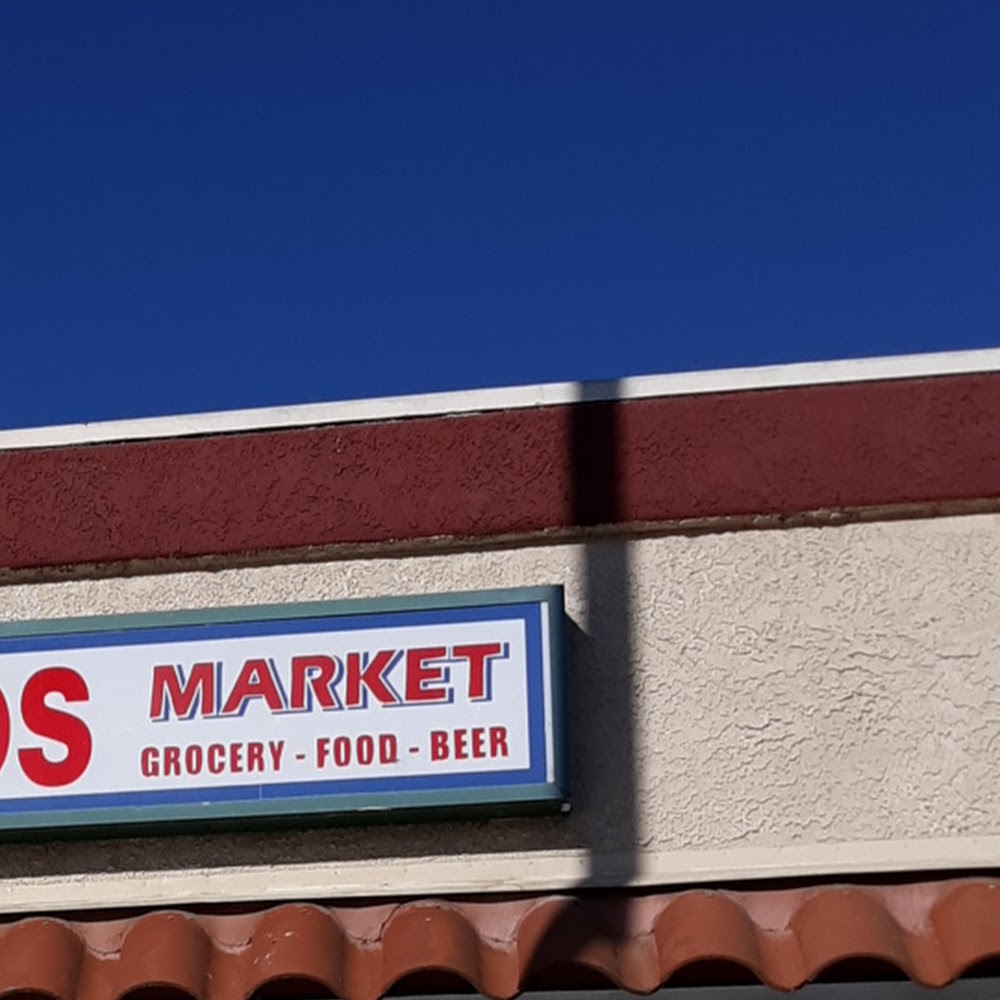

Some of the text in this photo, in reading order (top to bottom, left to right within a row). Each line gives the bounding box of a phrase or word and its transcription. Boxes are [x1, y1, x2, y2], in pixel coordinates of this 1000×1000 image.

[149, 642, 510, 722] MARKET
[140, 740, 285, 778] GROCERY
[316, 733, 398, 769] FOOD
[430, 726, 510, 762] BEER
